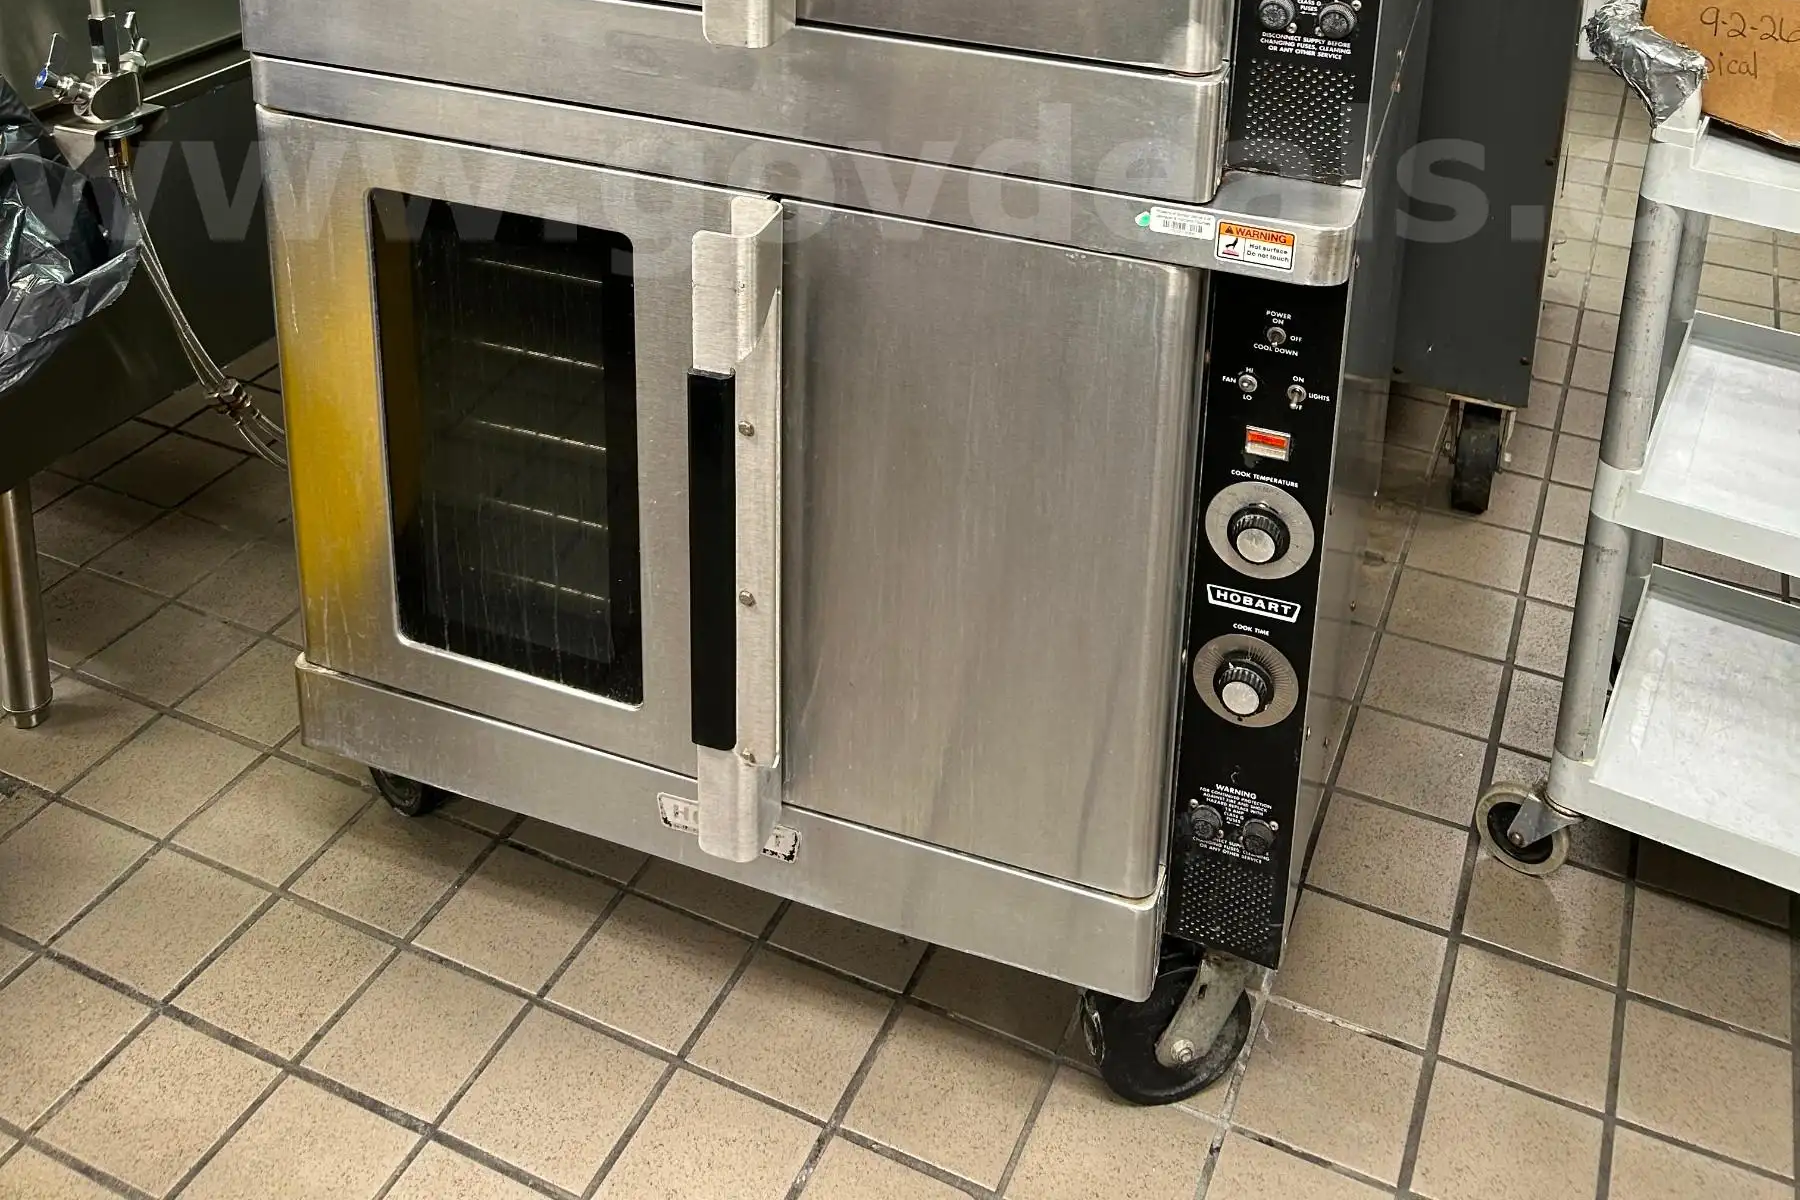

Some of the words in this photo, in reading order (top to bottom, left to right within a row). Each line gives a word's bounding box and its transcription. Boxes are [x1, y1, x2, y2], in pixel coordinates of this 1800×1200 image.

[1260, 38, 1295, 47] CHANGING
[1297, 42, 1317, 50] FUSES,
[1319, 45, 1352, 55] CLEANING
[1262, 32, 1301, 42] DISCONNECT
[1303, 36, 1325, 45] SUPPLY
[1327, 40, 1351, 48] BEFORE
[1317, 51, 1342, 60] SERVICE
[1235, 228, 1286, 244] WARNING
[1263, 246, 1288, 255] surface
[1270, 254, 1289, 262] touch
[1266, 310, 1292, 320] POWER
[1254, 343, 1273, 352] COOL
[1274, 347, 1298, 356] DOWN
[1308, 393, 1330, 402] LIGHTS
[1231, 469, 1251, 478] COOK
[1253, 473, 1299, 488] TEMPERATURE
[1216, 589, 1292, 616] HOBART
[1233, 623, 1252, 632] COOK
[1255, 627, 1270, 636] TIME
[1216, 784, 1257, 800] WARNING
[1203, 793, 1225, 801] AGAINST
[1250, 804, 1268, 812] SHOCK
[1206, 797, 1227, 806] HAZARD
[1241, 797, 1272, 810] PROTECTION
